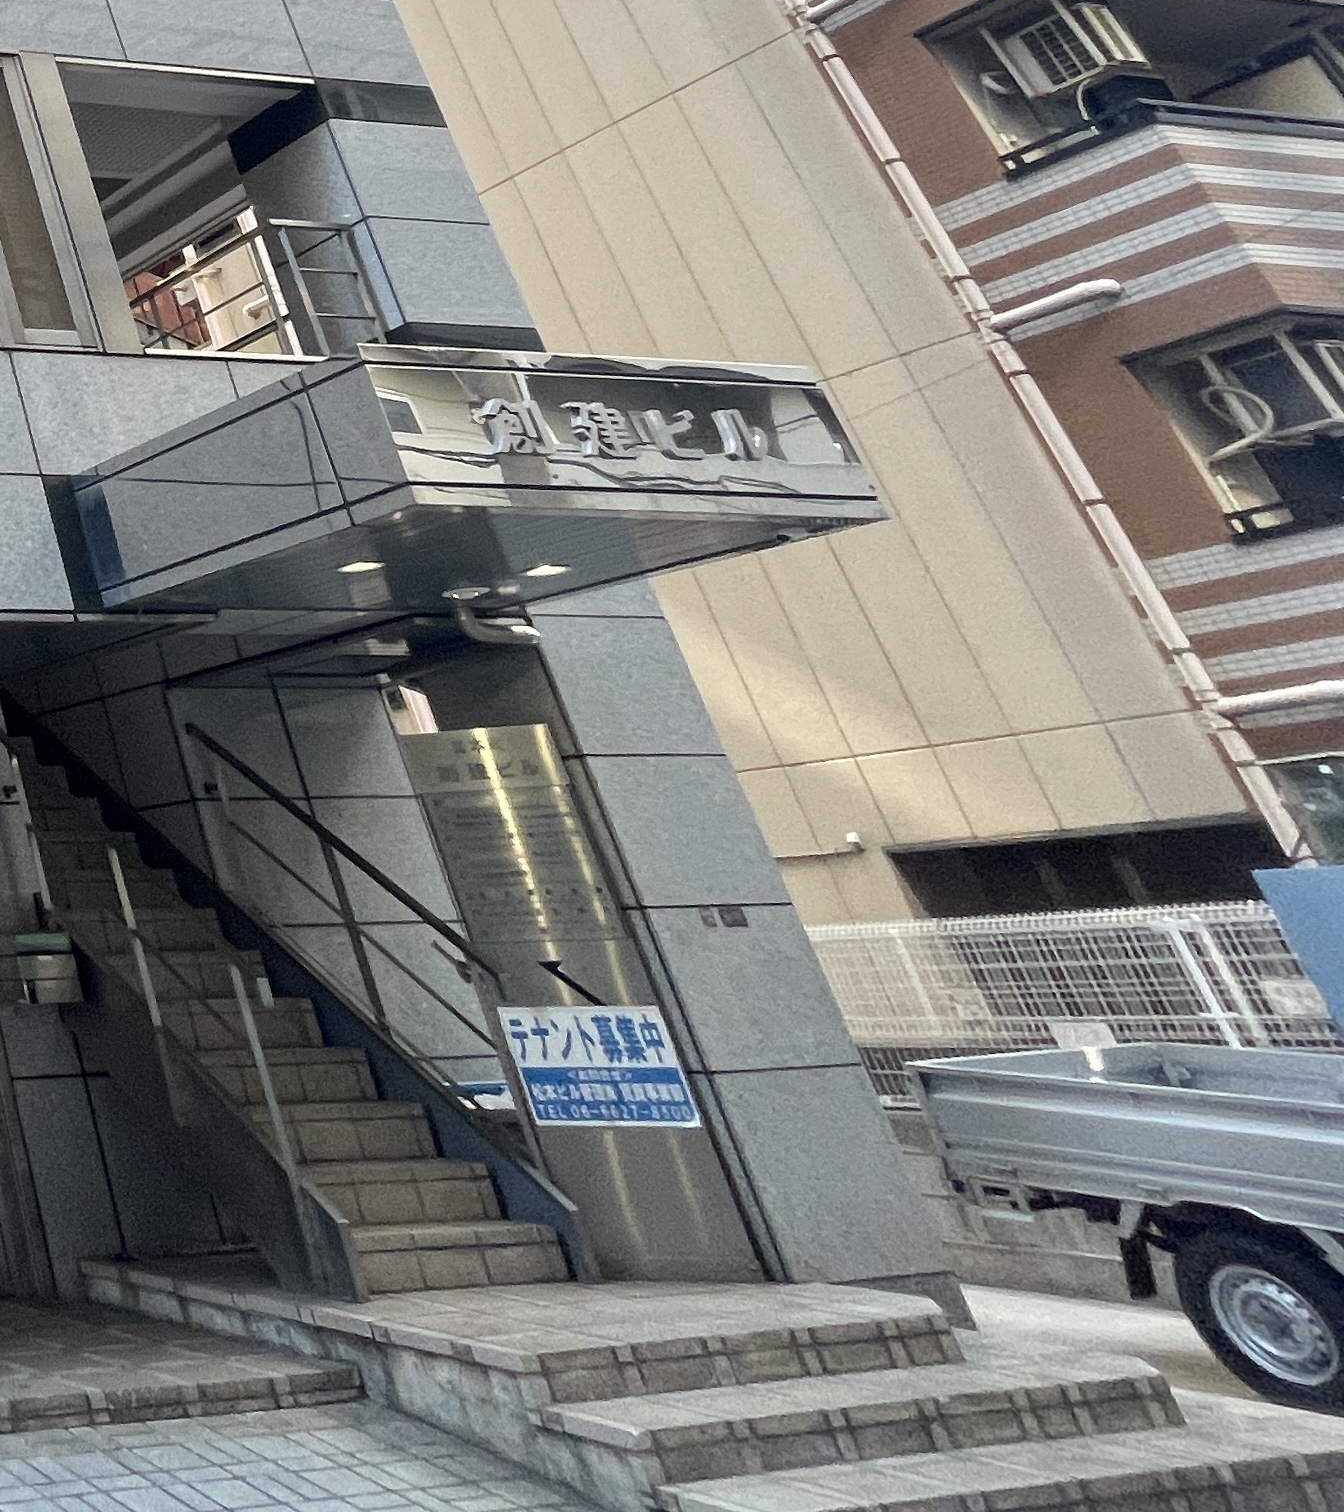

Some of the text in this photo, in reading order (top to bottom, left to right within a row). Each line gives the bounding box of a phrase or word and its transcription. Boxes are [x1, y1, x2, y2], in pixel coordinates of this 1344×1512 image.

[472, 397, 770, 462] 創建ビル
[509, 1013, 665, 1065] テナント募集中
[538, 1104, 568, 1120] TEL
